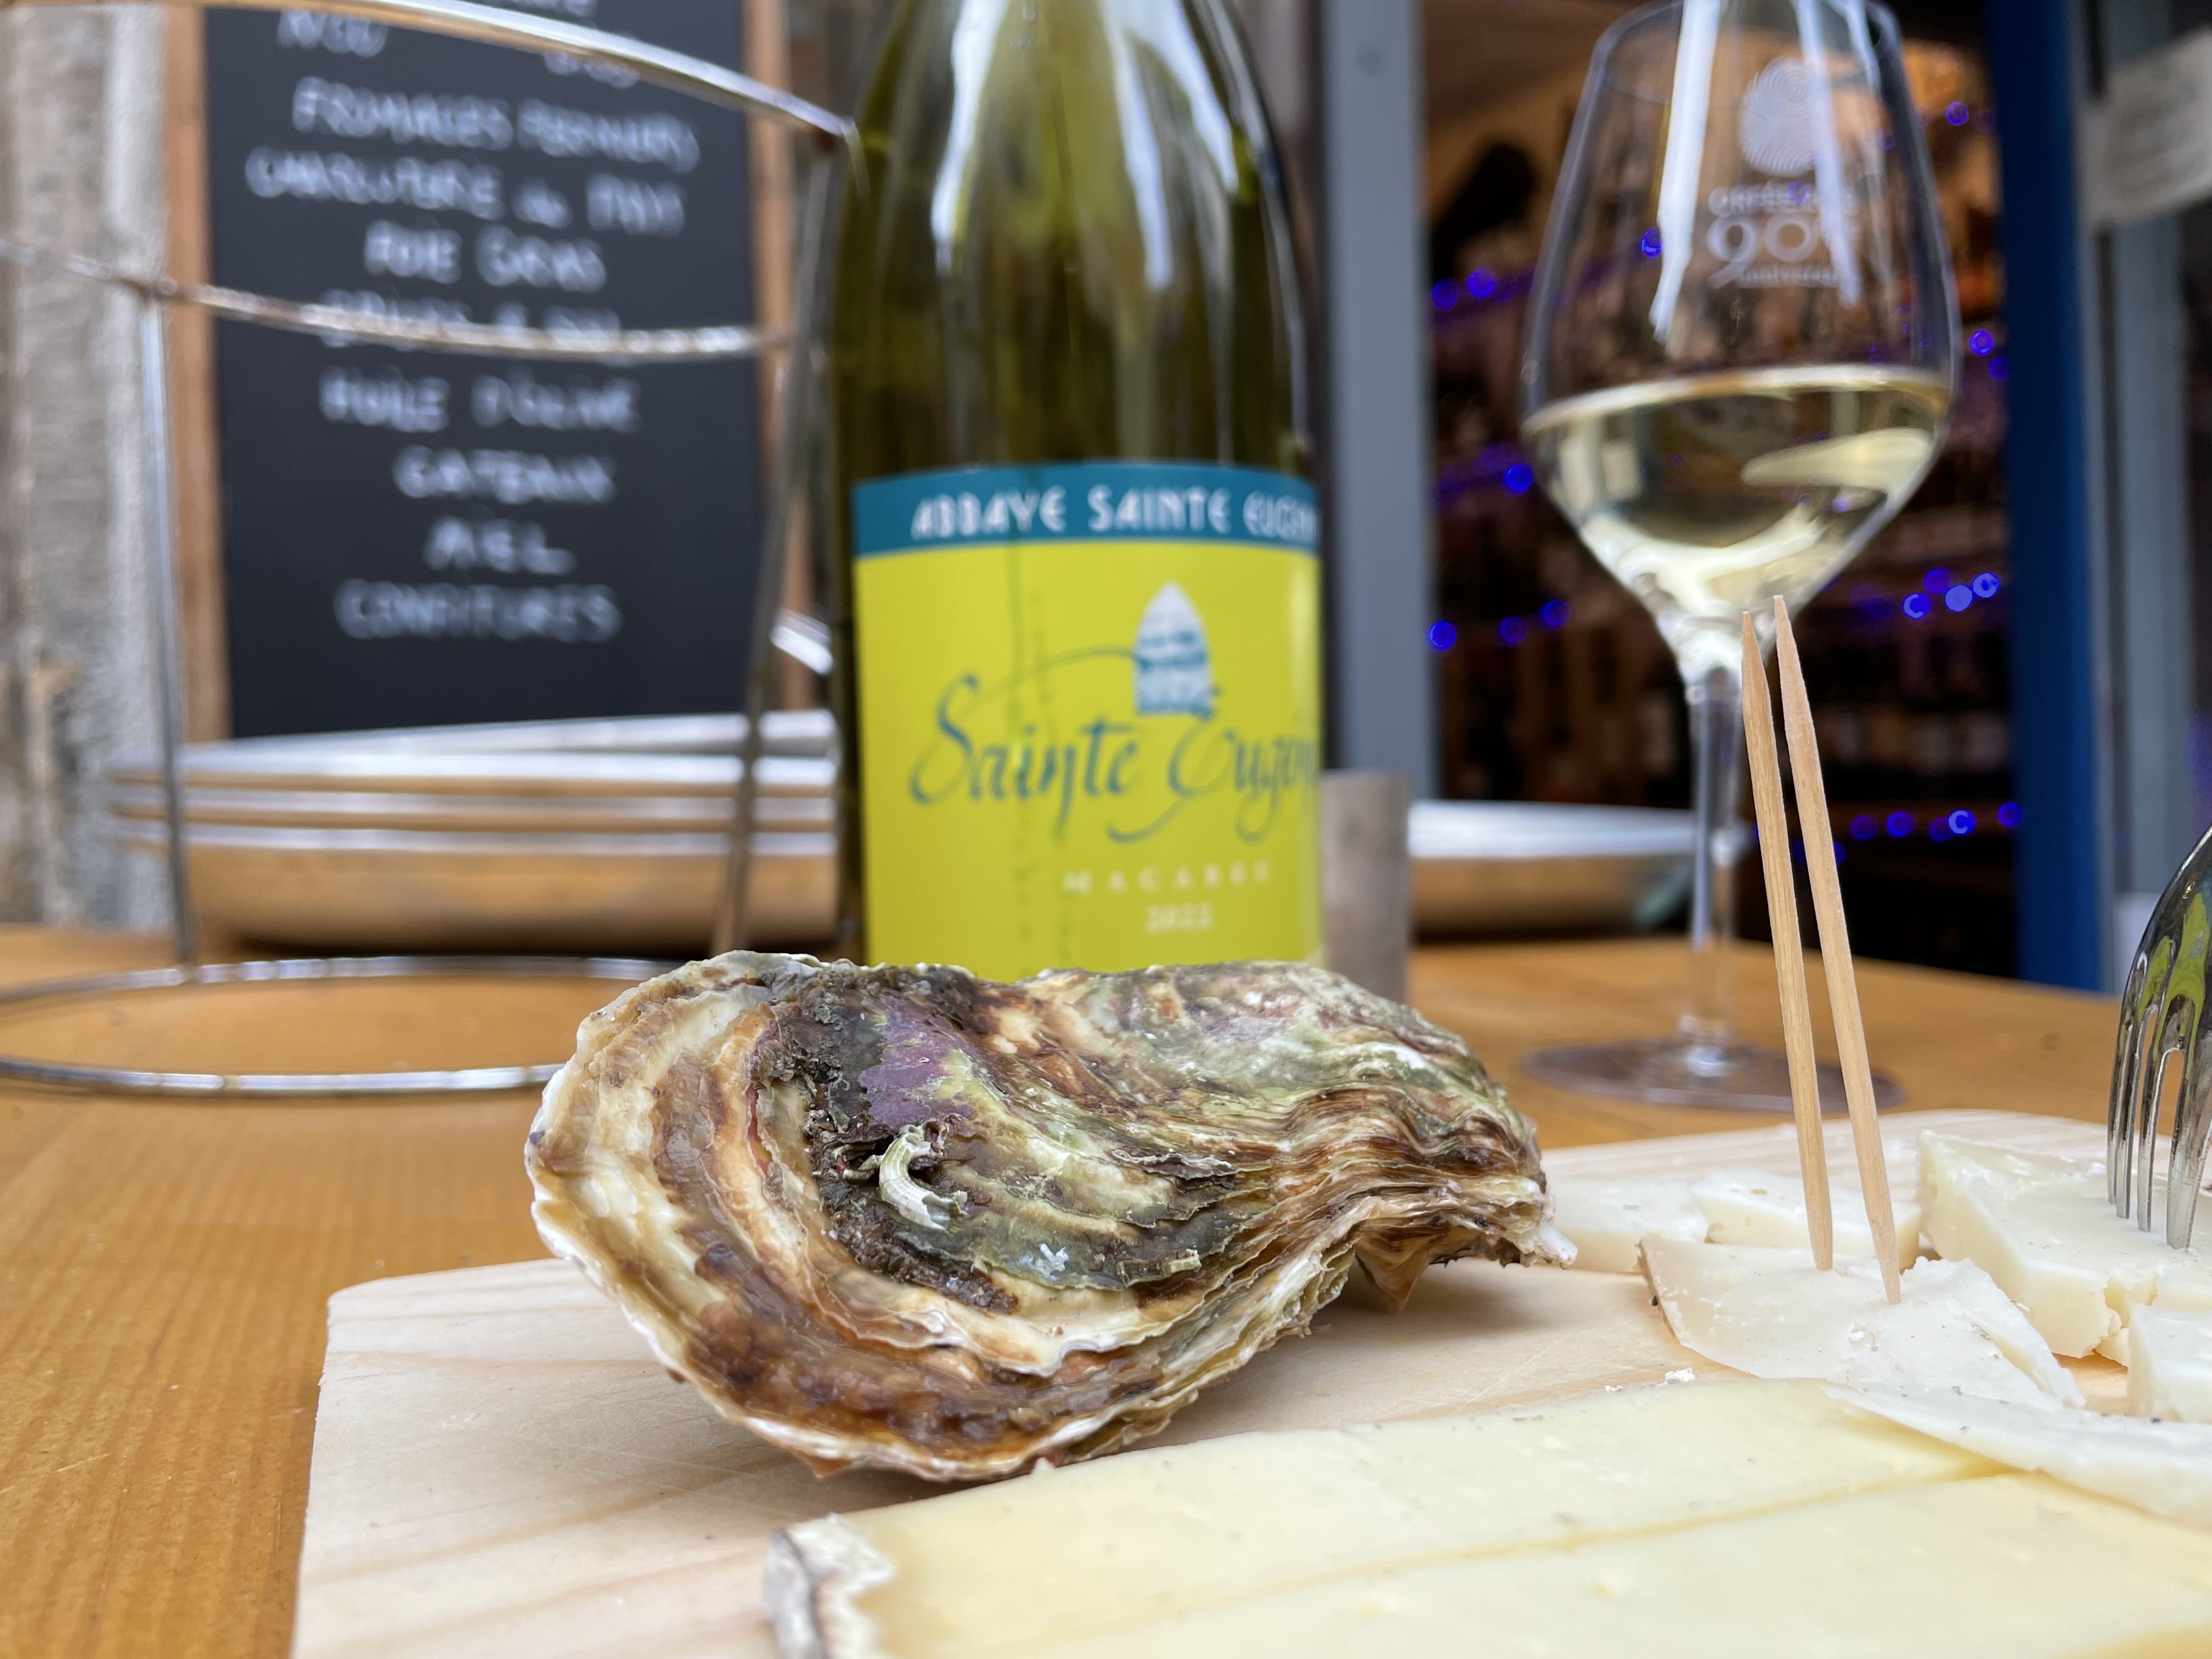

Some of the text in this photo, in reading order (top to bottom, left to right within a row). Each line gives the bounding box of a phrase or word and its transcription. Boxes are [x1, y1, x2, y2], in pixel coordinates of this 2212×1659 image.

[912, 486, 1068, 540] ABBAYE
[1087, 484, 1231, 535] SAINTE
[908, 670, 1142, 846] Sainte
